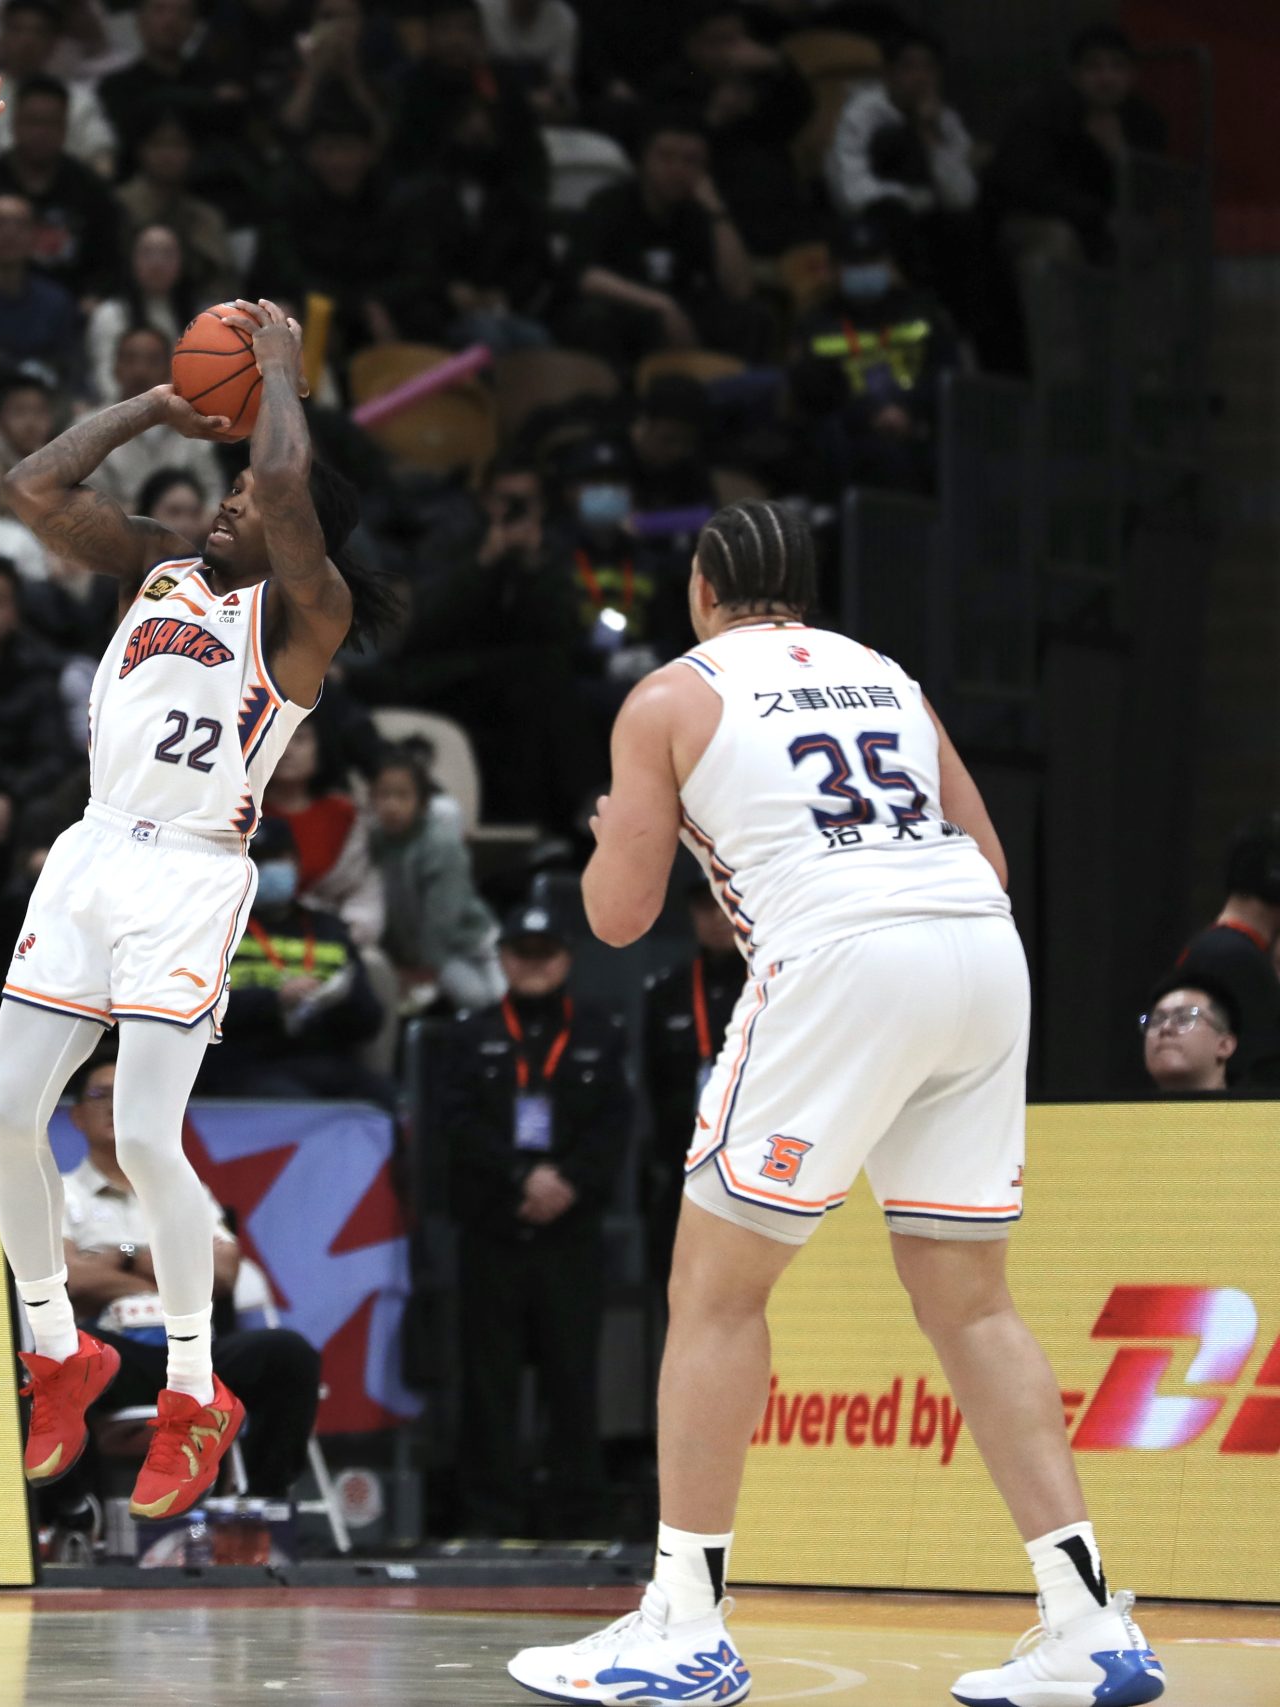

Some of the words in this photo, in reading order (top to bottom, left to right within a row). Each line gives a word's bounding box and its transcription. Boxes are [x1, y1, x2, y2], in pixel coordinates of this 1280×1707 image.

[119, 617, 235, 679] SHARKS
[754, 685, 902, 718] 久事体育
[154, 709, 223, 774] 22
[787, 731, 929, 830] 35
[750, 1375, 902, 1448] ivered
[909, 1376, 962, 1465] by
